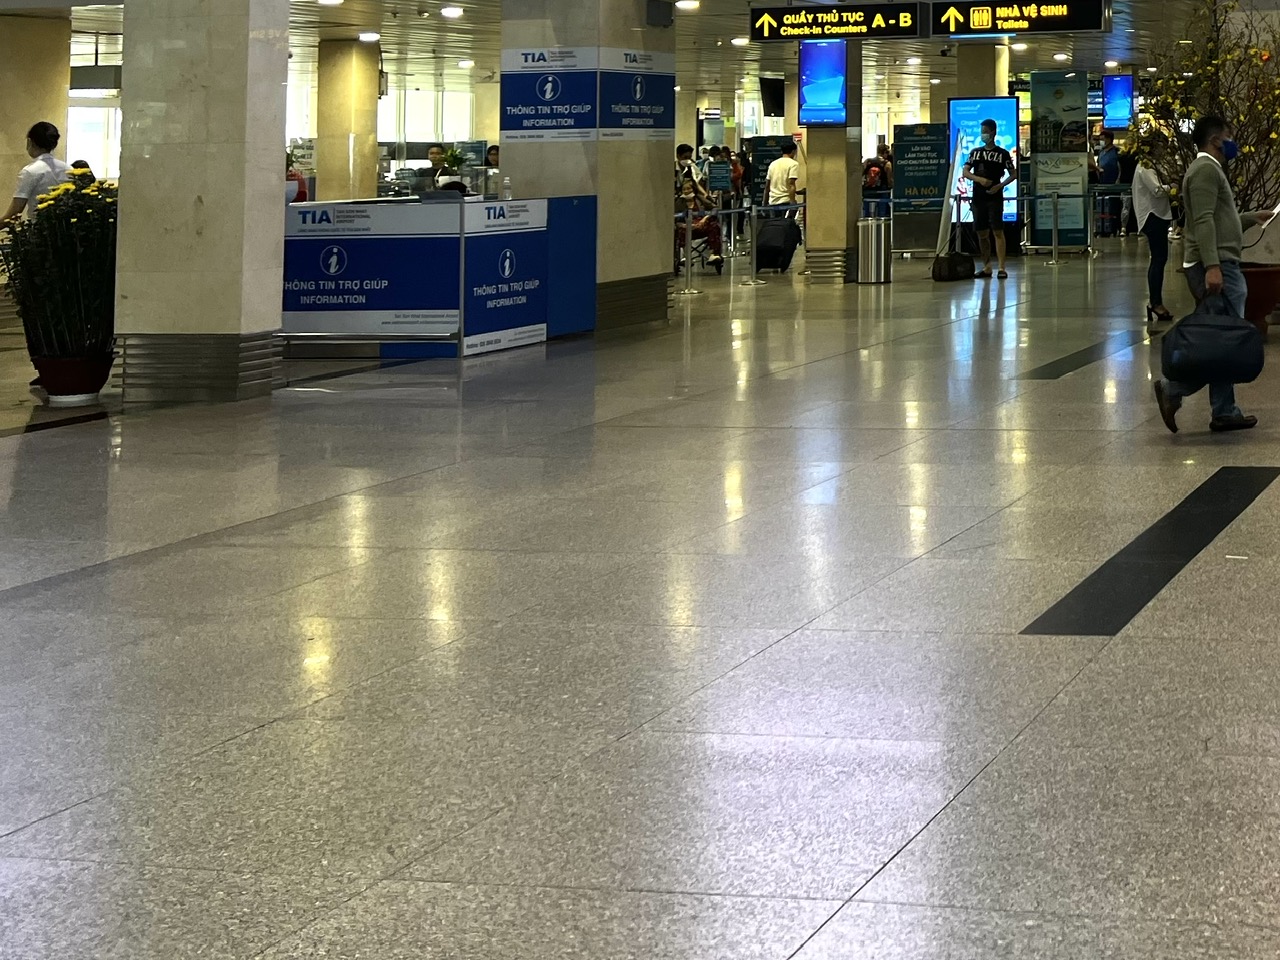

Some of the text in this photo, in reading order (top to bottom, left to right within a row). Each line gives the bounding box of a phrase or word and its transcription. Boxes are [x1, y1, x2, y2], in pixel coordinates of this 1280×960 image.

[996, 3, 1067, 18] NHÀ VỆ SINH
[816, 9, 839, 23] THỦ
[841, 11, 864, 23] TỤC
[871, 13, 886, 28] A
[899, 12, 912, 27] B
[996, 19, 1029, 29] Toilets
[780, 24, 867, 35] Check-in Counters
[521, 53, 547, 63] TIA
[624, 53, 638, 63] TIA
[506, 103, 592, 115] THÔNG TIN TRỢ GIÚP
[631, 105, 639, 113] TIN
[522, 118, 574, 127] INFORMATION
[921, 186, 938, 196] NỘI
[298, 210, 332, 224] TIA
[485, 206, 506, 220] TIA
[284, 278, 388, 291] HÔNG TIN TRỢ GIÚP
[473, 277, 540, 296] THÔNG TIN TRỢ GIÚP
[300, 295, 366, 304] INFORMATION
[486, 296, 527, 308] INFORMATION
